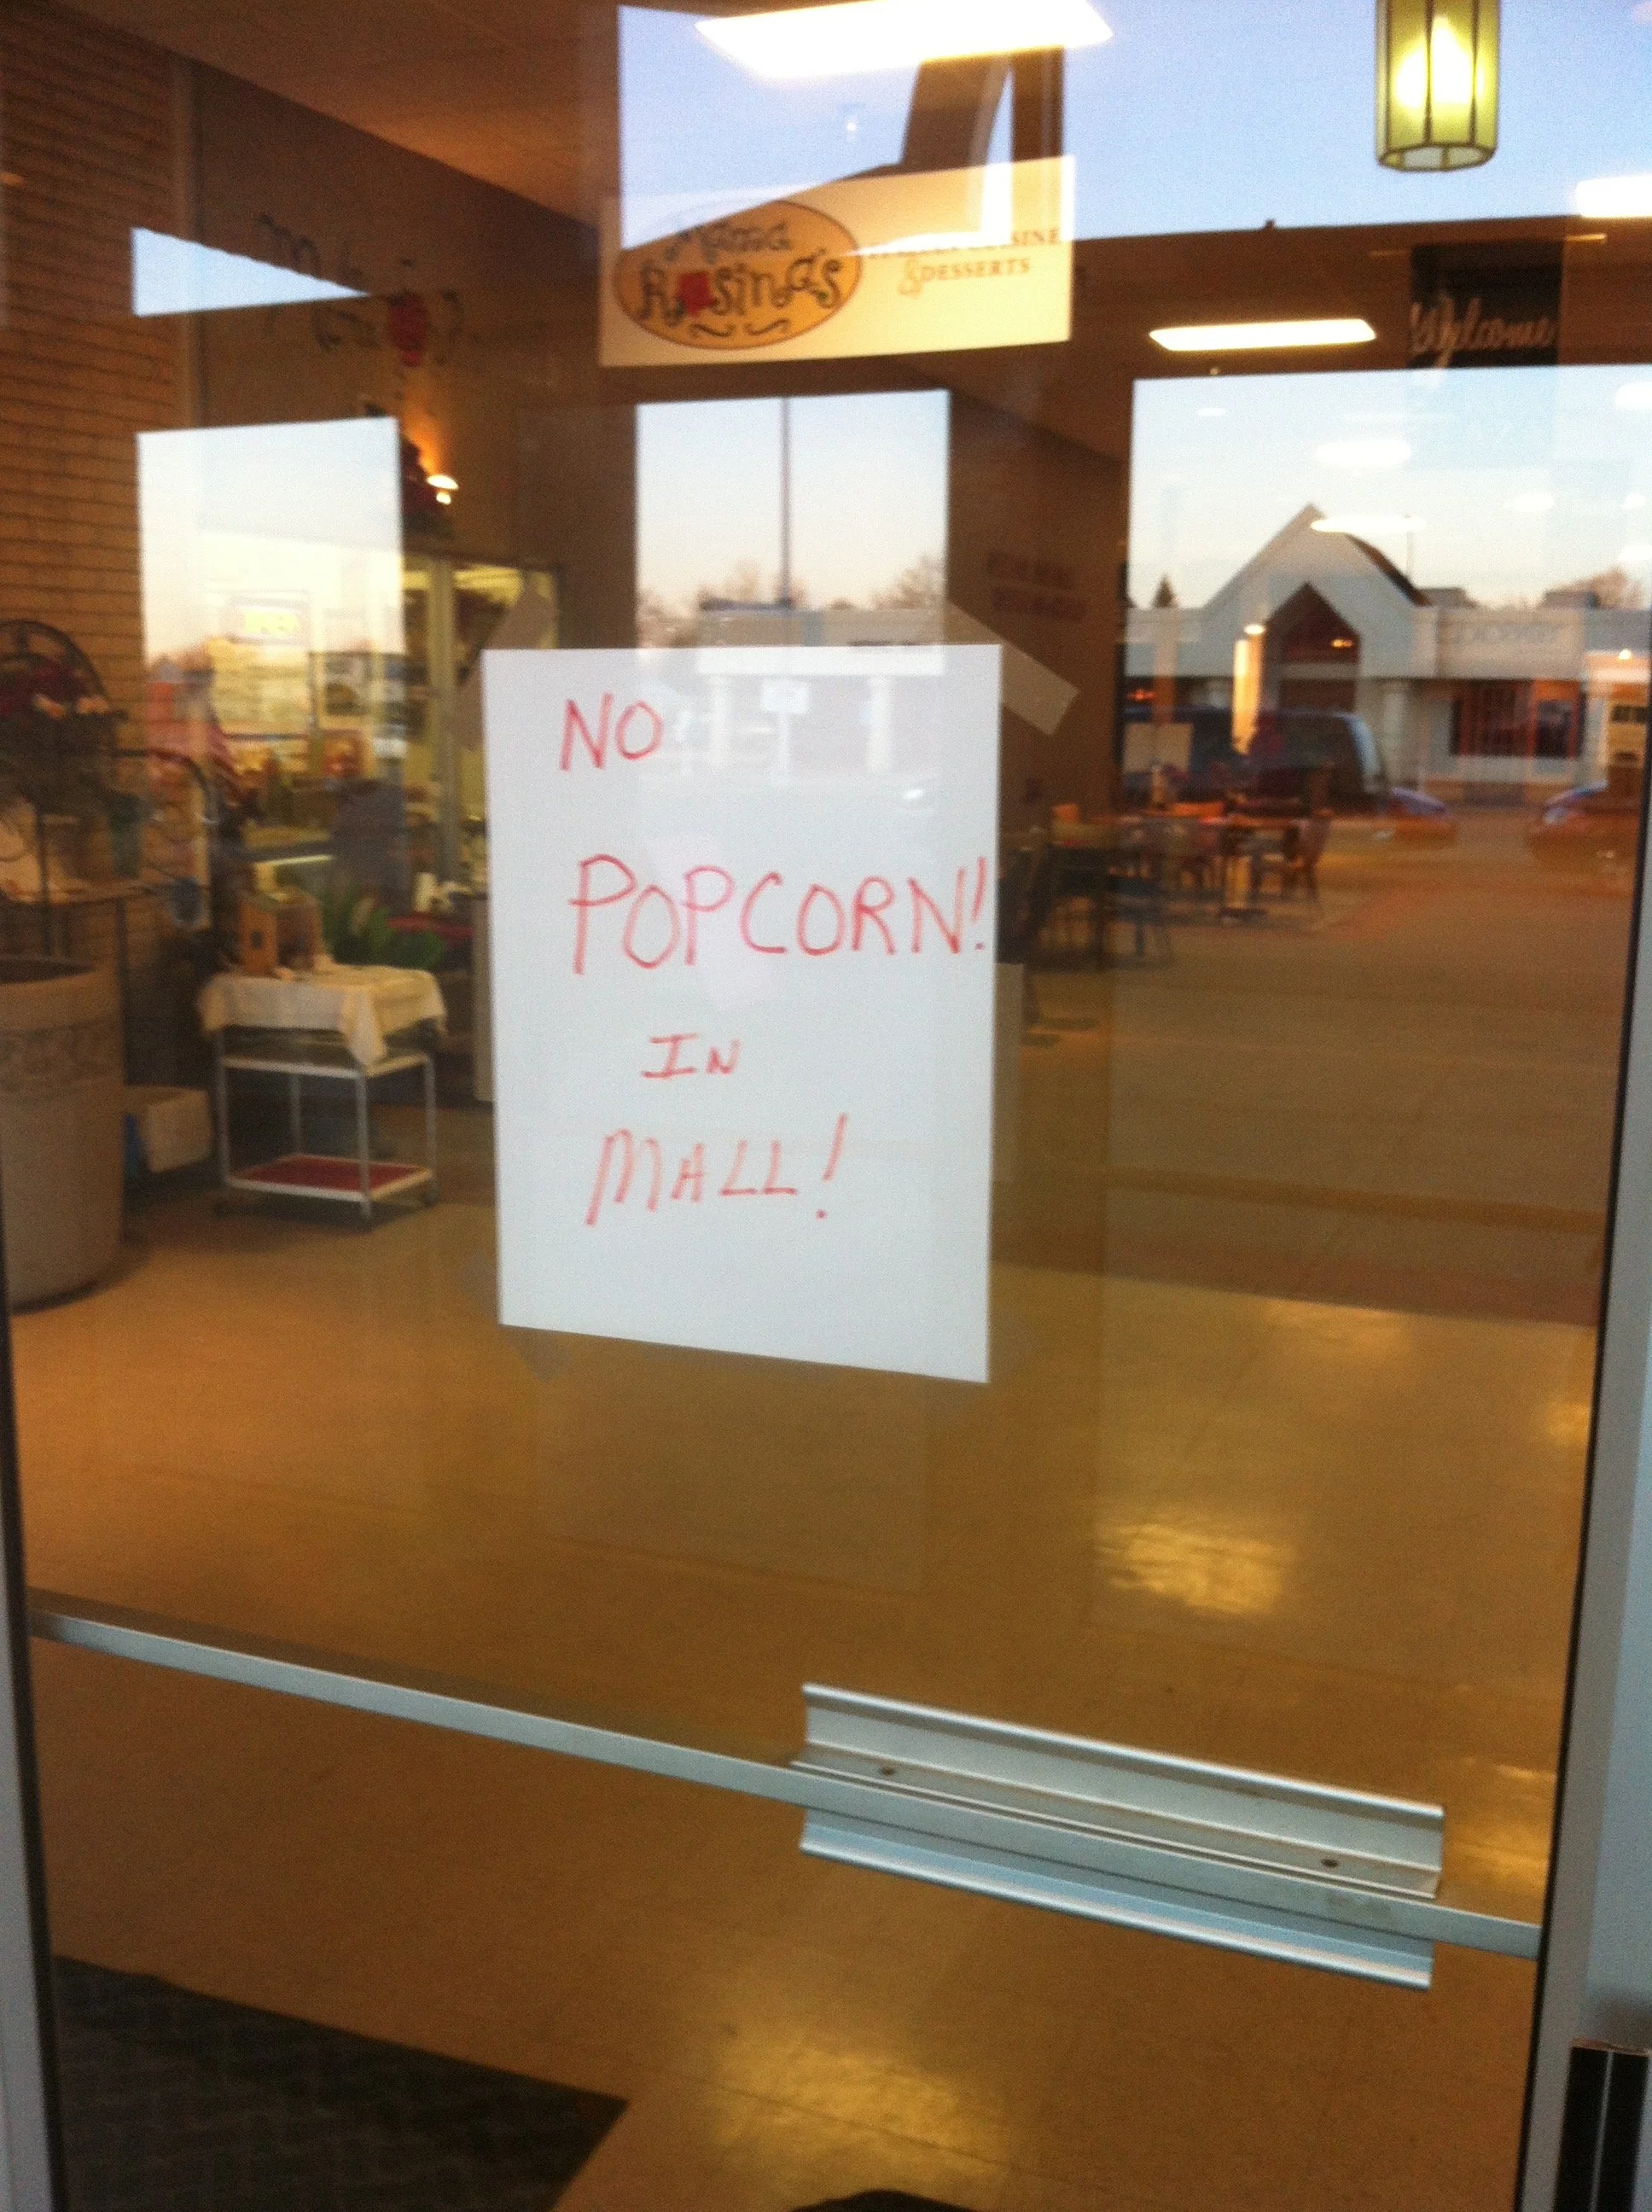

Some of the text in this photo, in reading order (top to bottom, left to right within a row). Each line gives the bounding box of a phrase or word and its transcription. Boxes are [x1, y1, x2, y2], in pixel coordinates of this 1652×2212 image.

[559, 692, 664, 771] NO
[567, 853, 987, 975] POPCORN!
[640, 1032, 742, 1080] IN
[585, 1112, 848, 1226] MALL!
